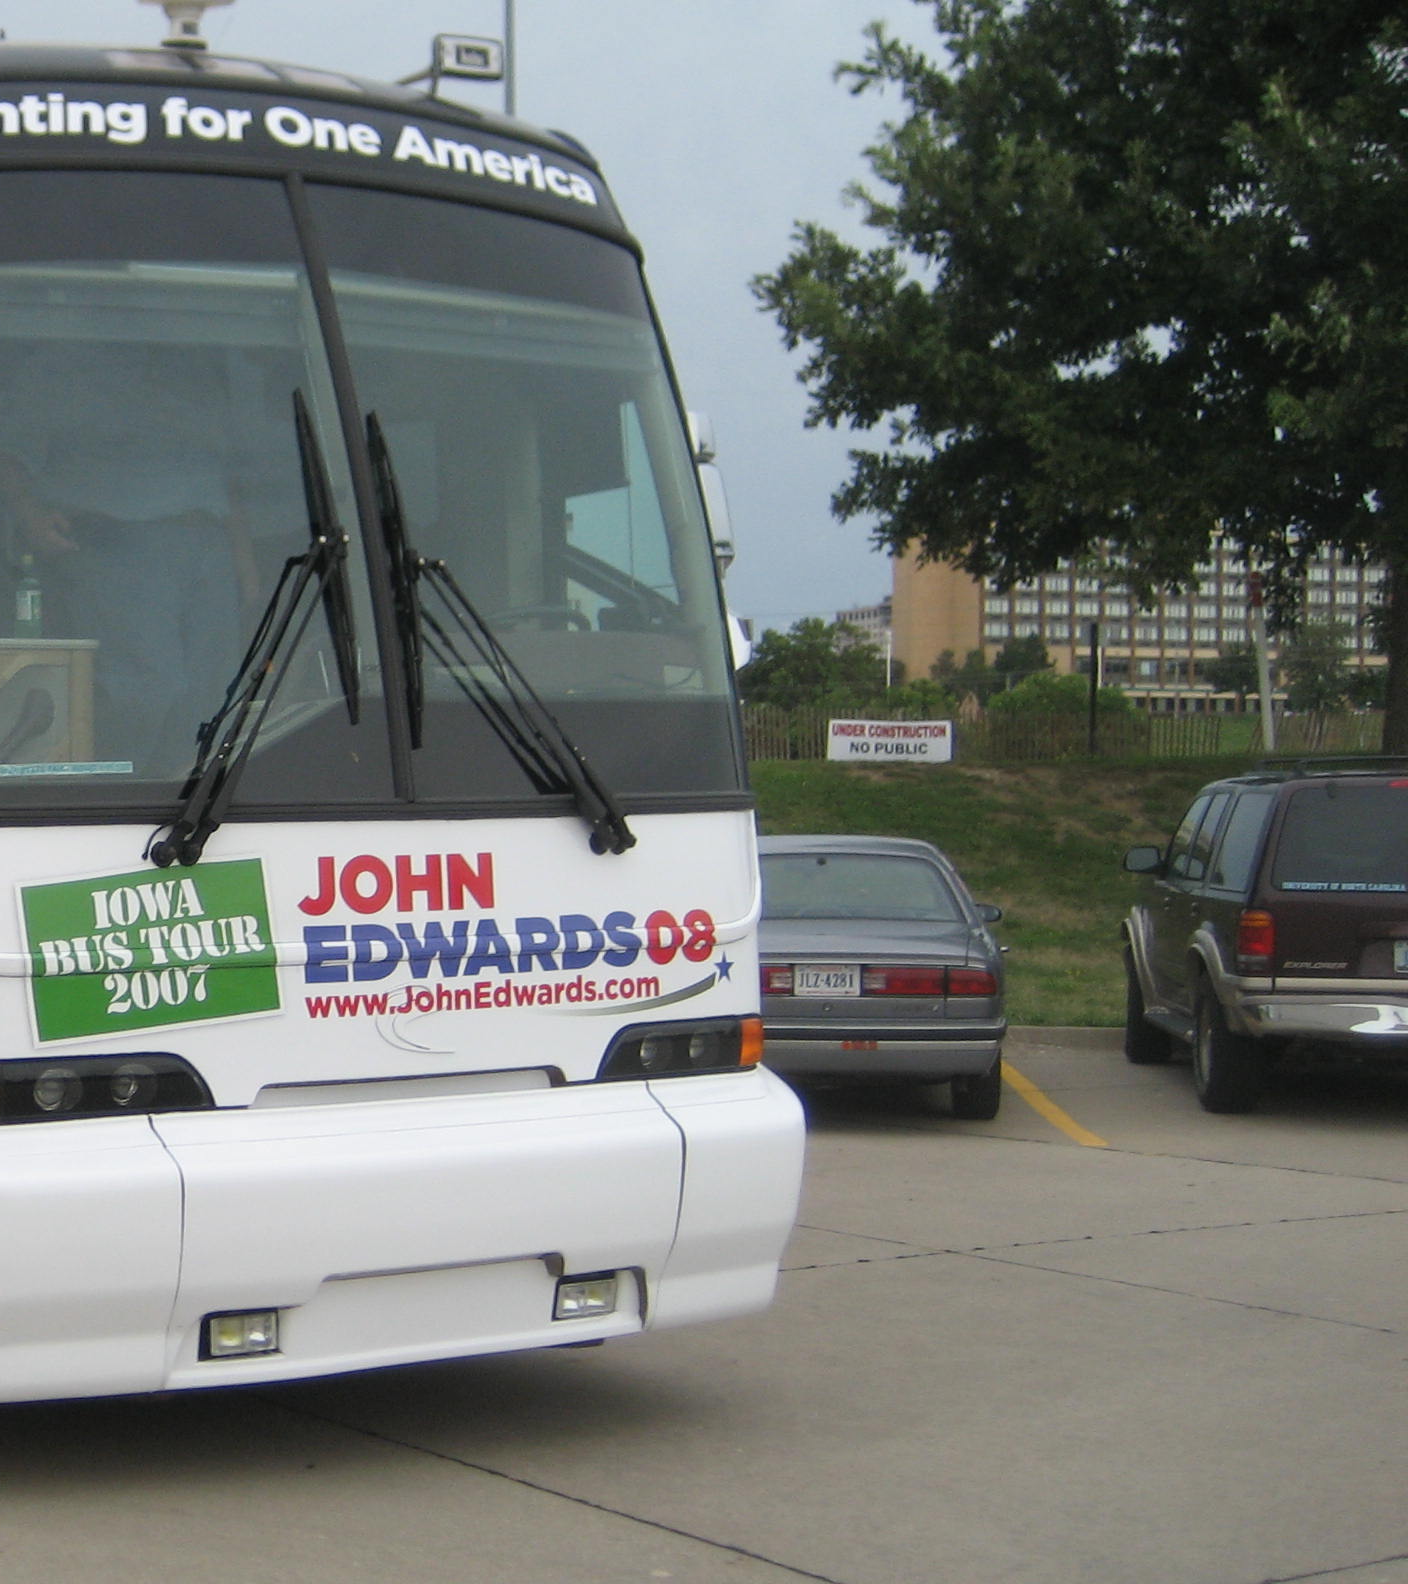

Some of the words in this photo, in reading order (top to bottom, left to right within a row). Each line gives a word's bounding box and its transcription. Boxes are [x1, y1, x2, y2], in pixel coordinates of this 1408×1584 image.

[162, 96, 251, 142] for
[265, 105, 381, 157] One
[393, 125, 598, 205] America
[832, 723, 866, 738] UNDER
[868, 724, 947, 739] CONSTRUCTION
[849, 742, 870, 754] NO
[874, 743, 929, 755] PUBLIC
[91, 878, 205, 931] IOWA
[298, 852, 495, 917] JOHN
[39, 930, 134, 977] BUS
[139, 914, 267, 965] TOUR
[103, 964, 211, 1015] 2007
[305, 974, 661, 1019] www.JohnEdwards.com
